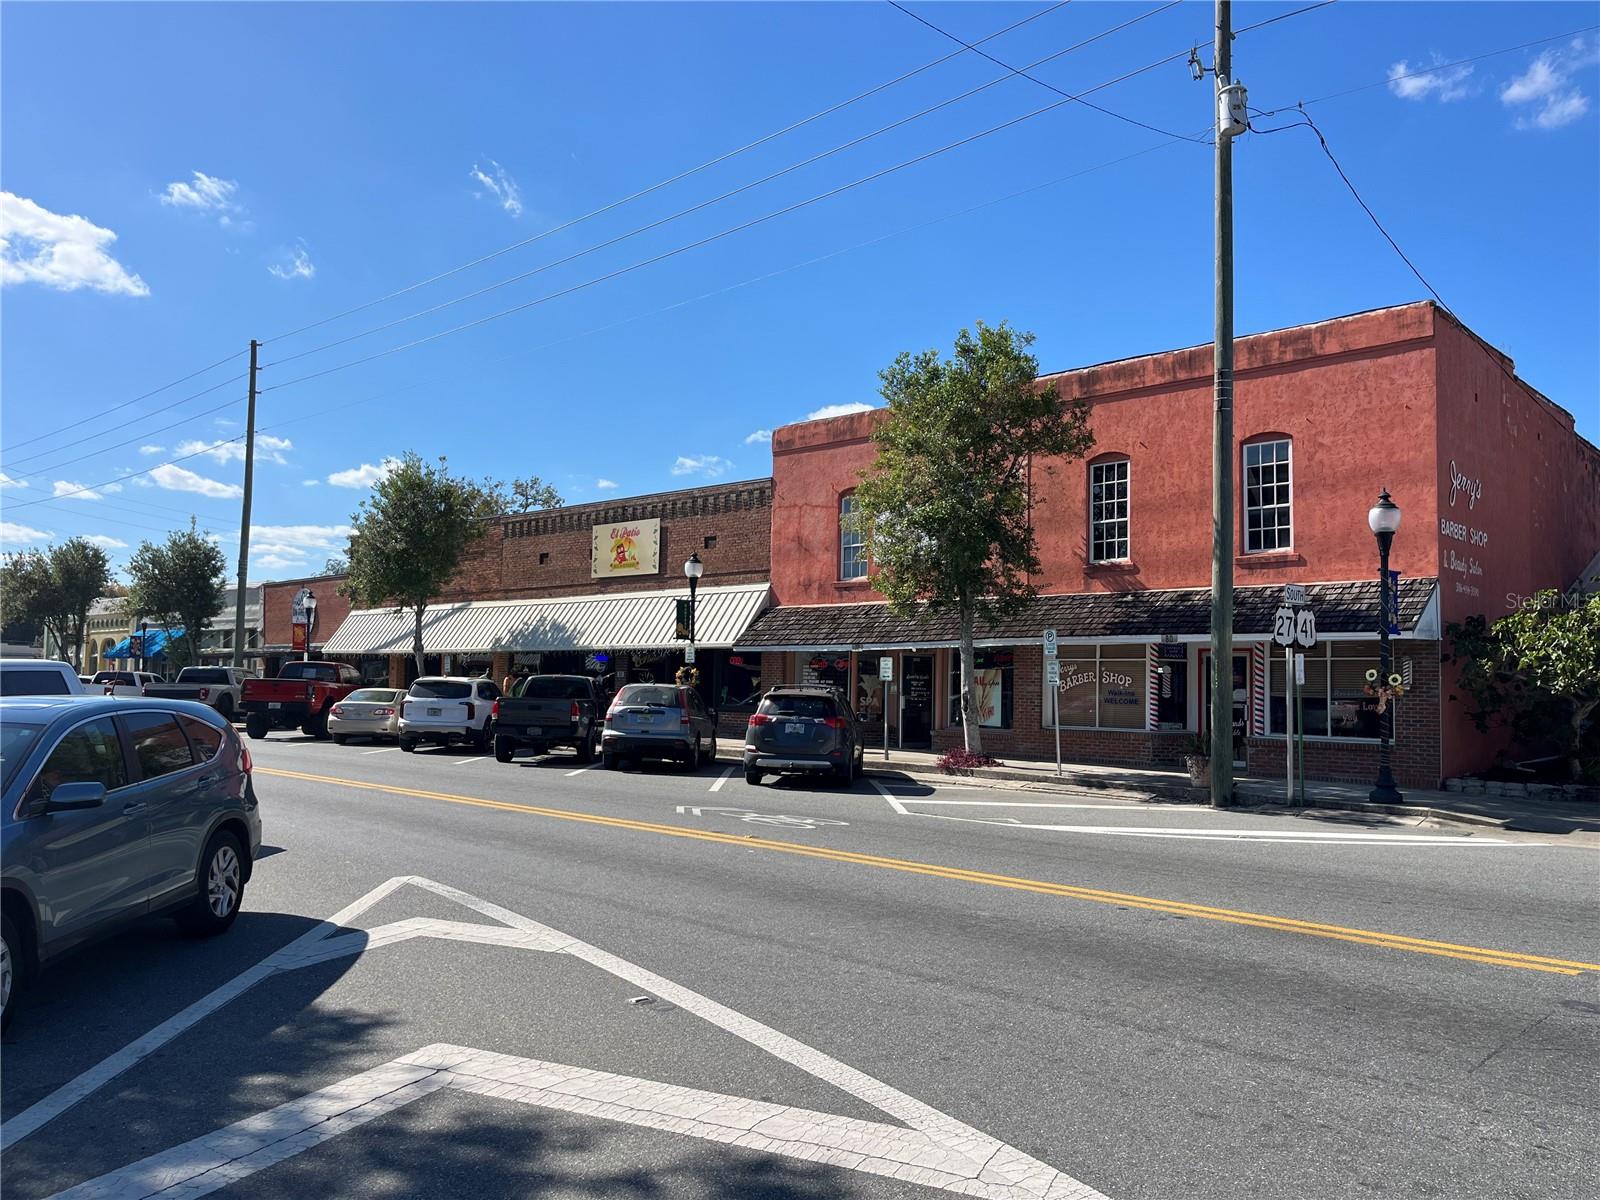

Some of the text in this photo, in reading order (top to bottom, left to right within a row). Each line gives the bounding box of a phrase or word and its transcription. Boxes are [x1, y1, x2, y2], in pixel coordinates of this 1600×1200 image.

[1449, 460, 1482, 510] Jerry's
[610, 527, 640, 539] El Patio
[1441, 519, 1488, 548] BARBER SHOP
[1450, 550, 1468, 579] Beauty
[1469, 558, 1483, 576] Salon
[1286, 587, 1304, 601] SOUTH
[1047, 632, 1053, 640] P
[1276, 615, 1293, 638] 27
[1301, 617, 1314, 639] 41
[1060, 671, 1132, 692] BARBER SHOP
[860, 696, 879, 706] SPA
